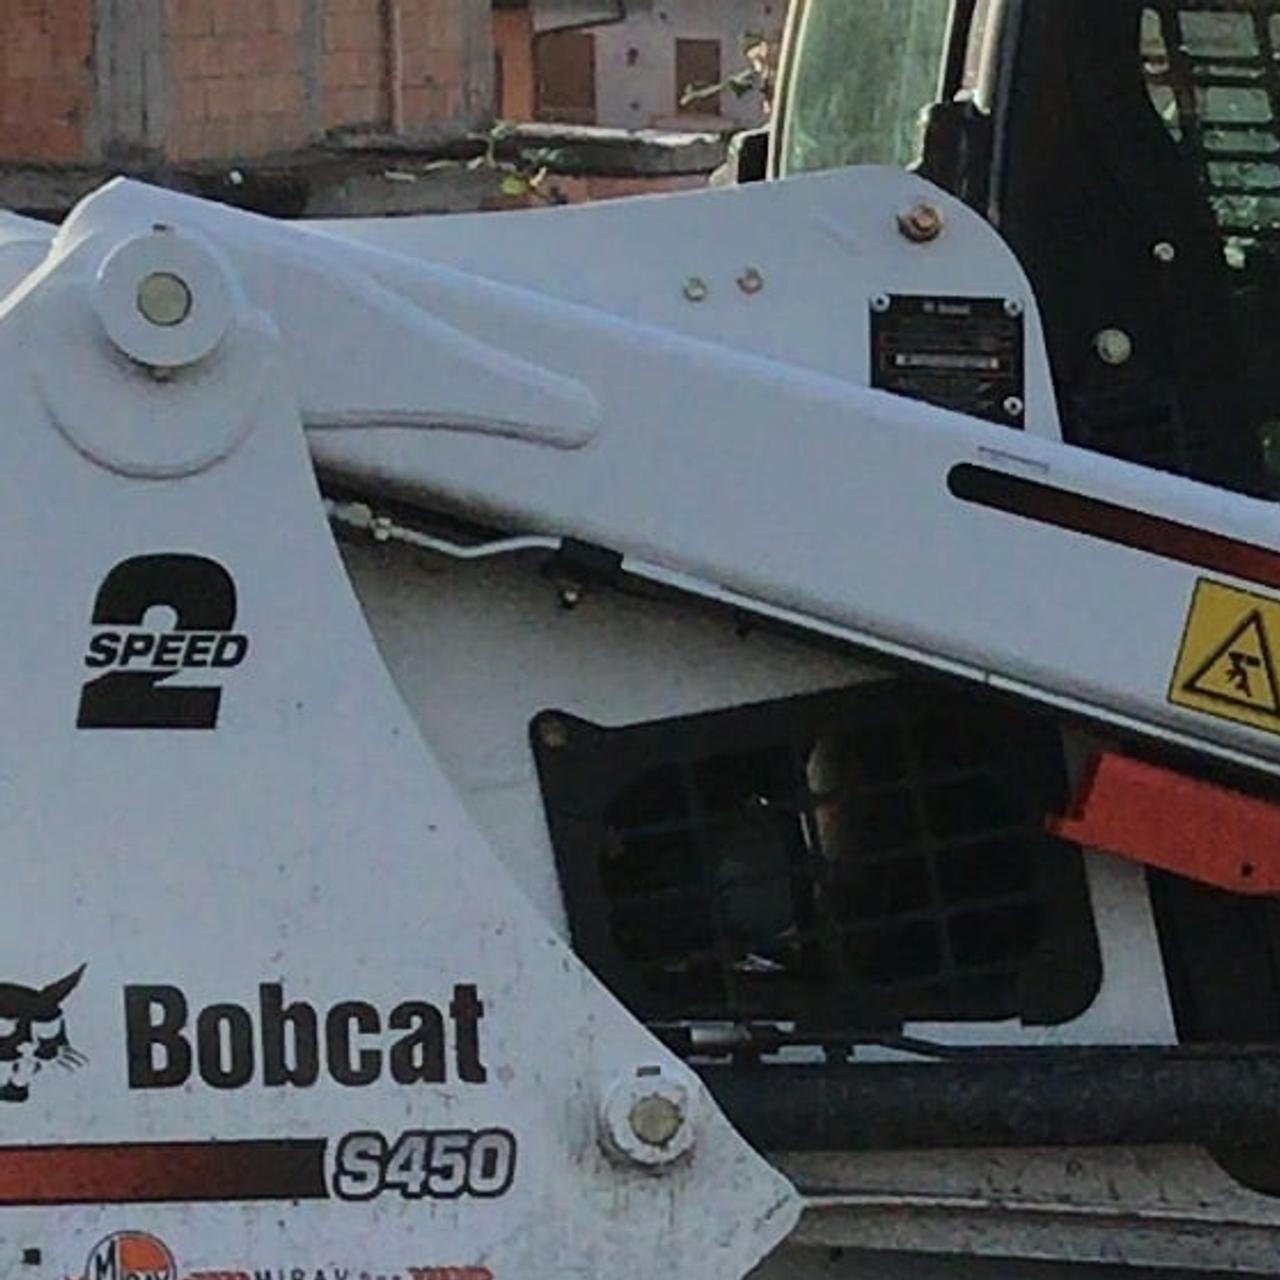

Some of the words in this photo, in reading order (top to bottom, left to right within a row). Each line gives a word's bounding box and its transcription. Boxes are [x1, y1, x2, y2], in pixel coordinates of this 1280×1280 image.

[76, 553, 237, 729] 2
[84, 632, 248, 668] SPEED
[123, 983, 488, 1090] Bobcat
[333, 1128, 517, 1200] S450
